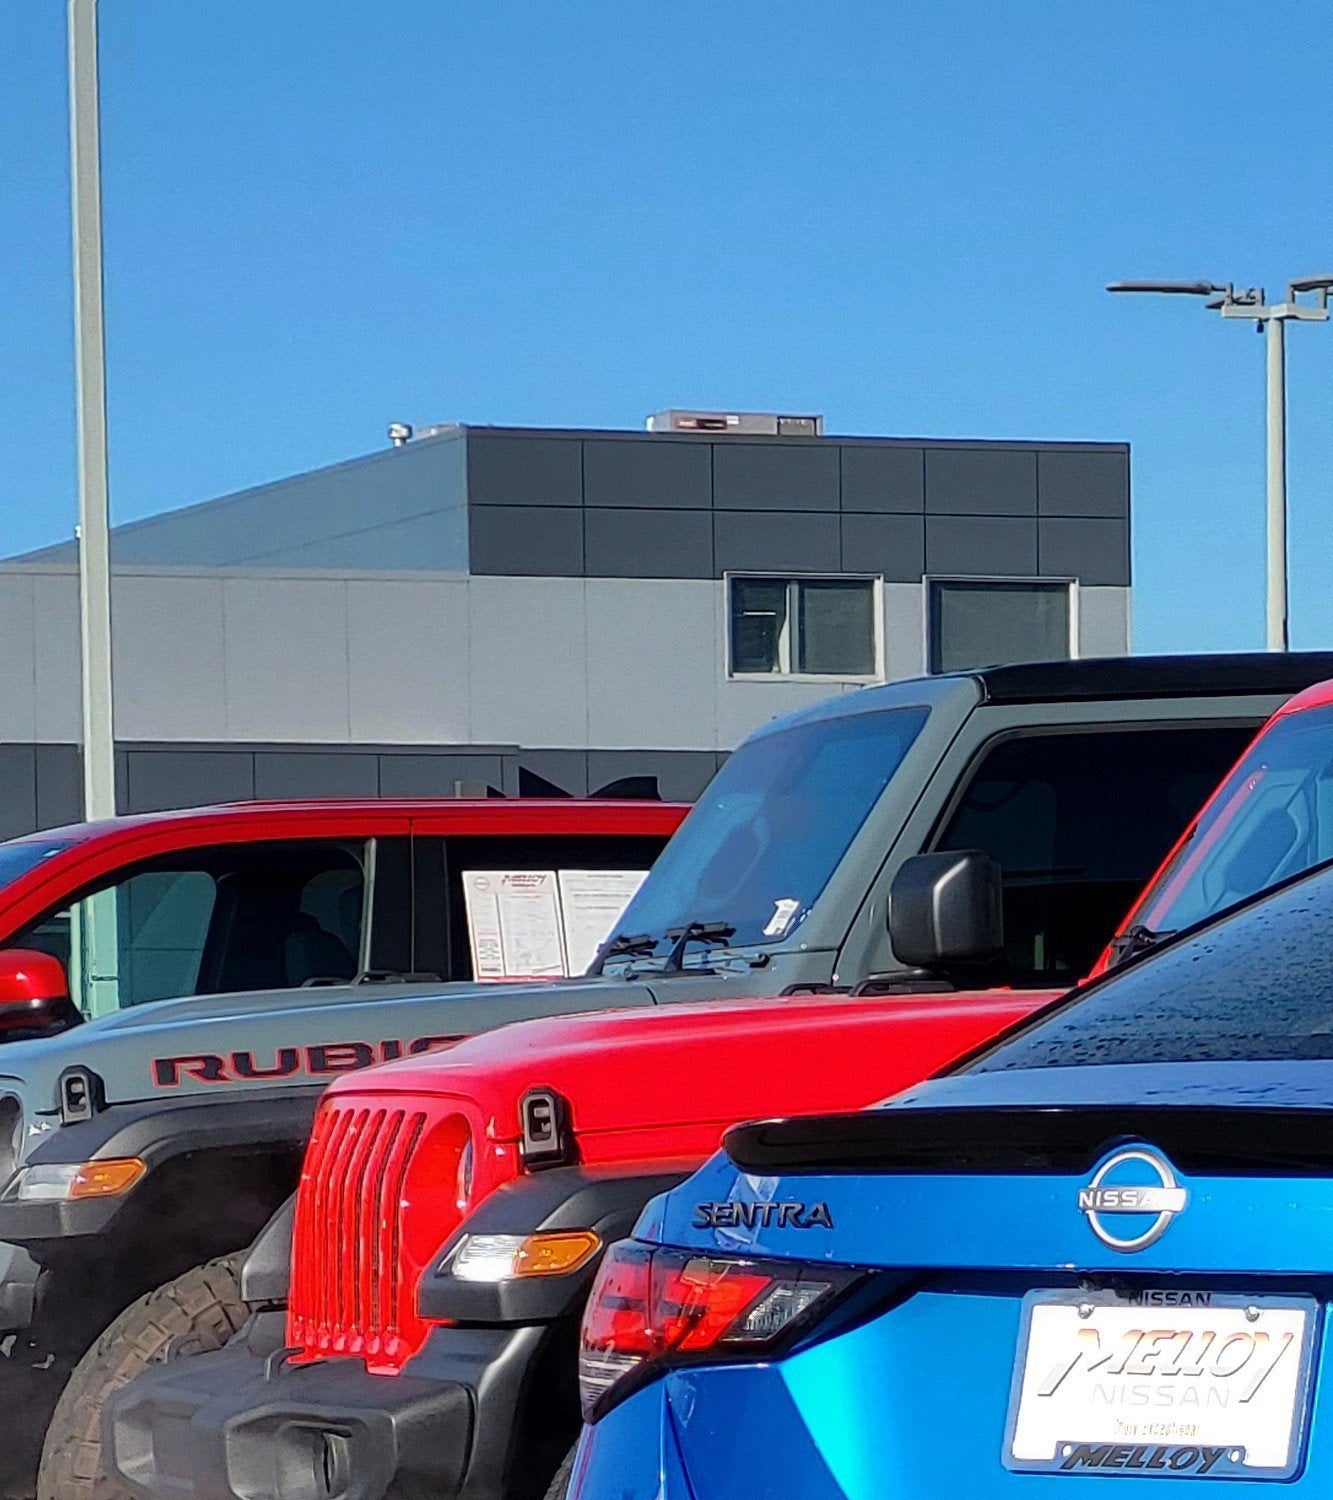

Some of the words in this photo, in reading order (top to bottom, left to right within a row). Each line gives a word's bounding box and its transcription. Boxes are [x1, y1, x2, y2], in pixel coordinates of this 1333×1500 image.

[1079, 1189, 1179, 1208] NISSA
[692, 1201, 835, 1230] SENTRA
[1128, 1291, 1212, 1306] NISSAN
[1037, 1328, 1295, 1404] MELLOY
[1092, 1384, 1230, 1408] NISSAN
[1061, 1444, 1223, 1475] MELLOY
